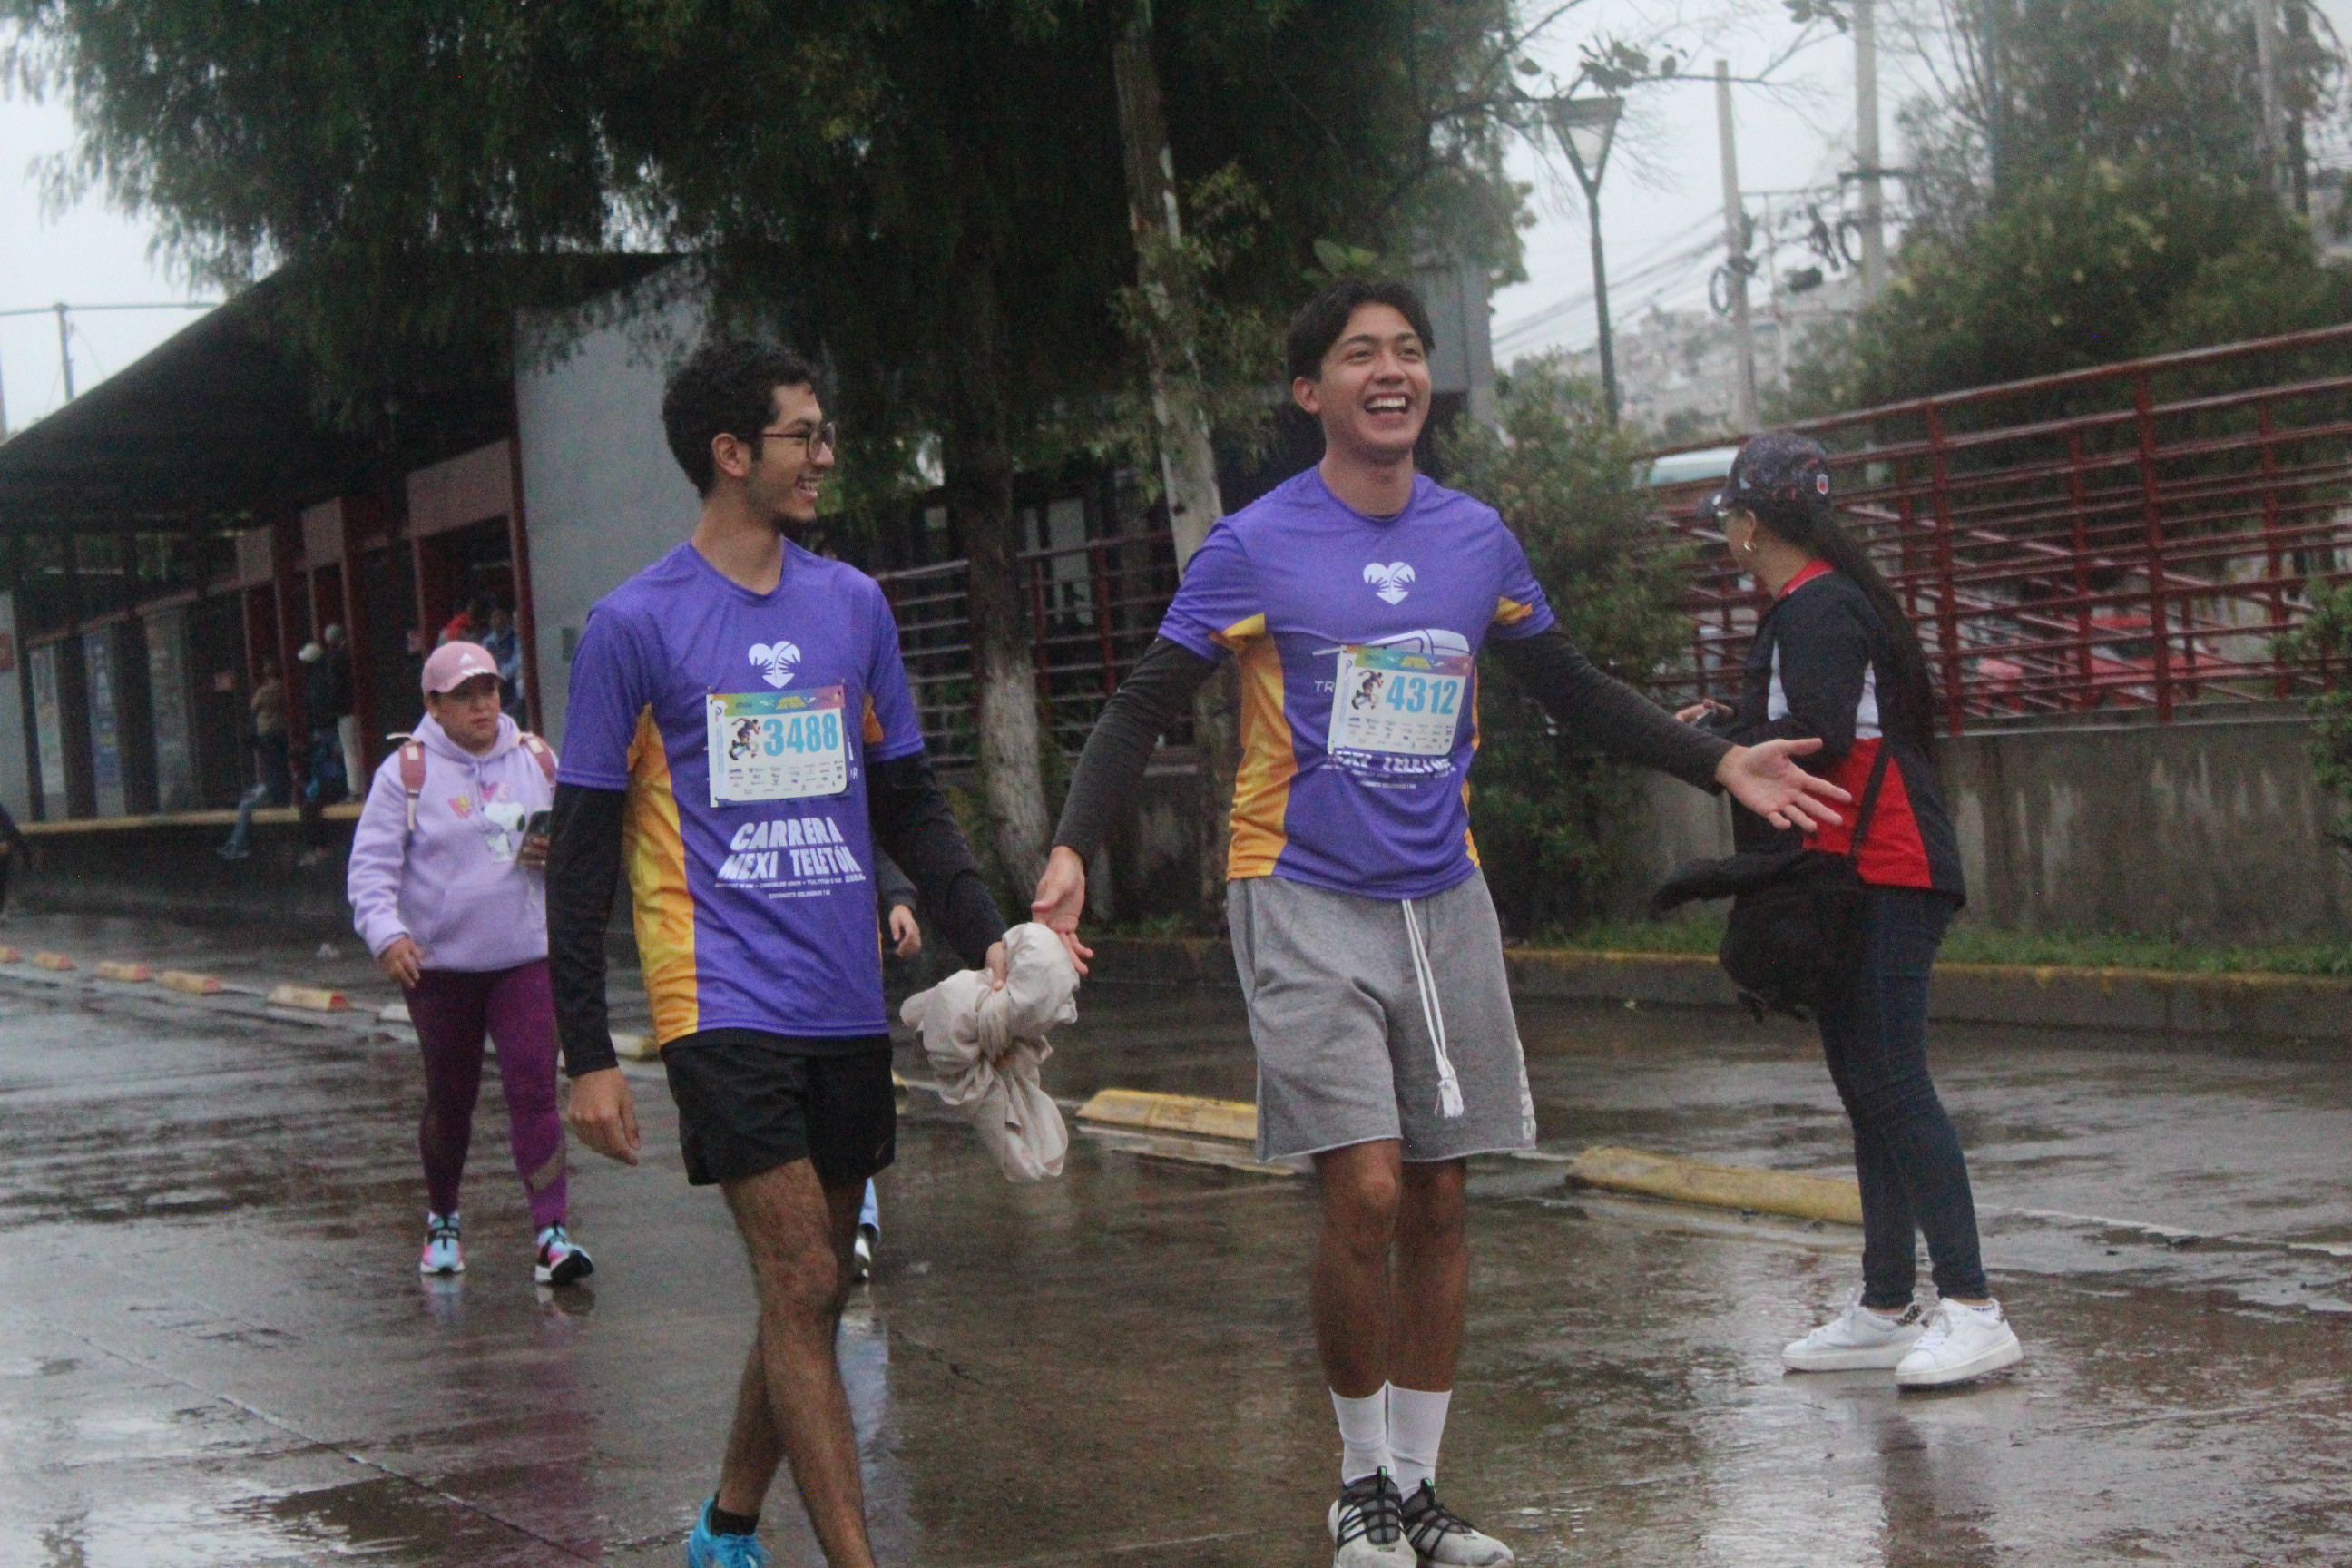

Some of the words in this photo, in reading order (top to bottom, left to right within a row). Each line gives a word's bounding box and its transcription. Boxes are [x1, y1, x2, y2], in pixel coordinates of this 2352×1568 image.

[1386, 675, 1458, 715] 4312
[763, 713, 839, 756] 3488
[730, 816, 844, 851] CARRERA
[716, 851, 779, 881] MEXI
[789, 845, 863, 877] TELETÓN
